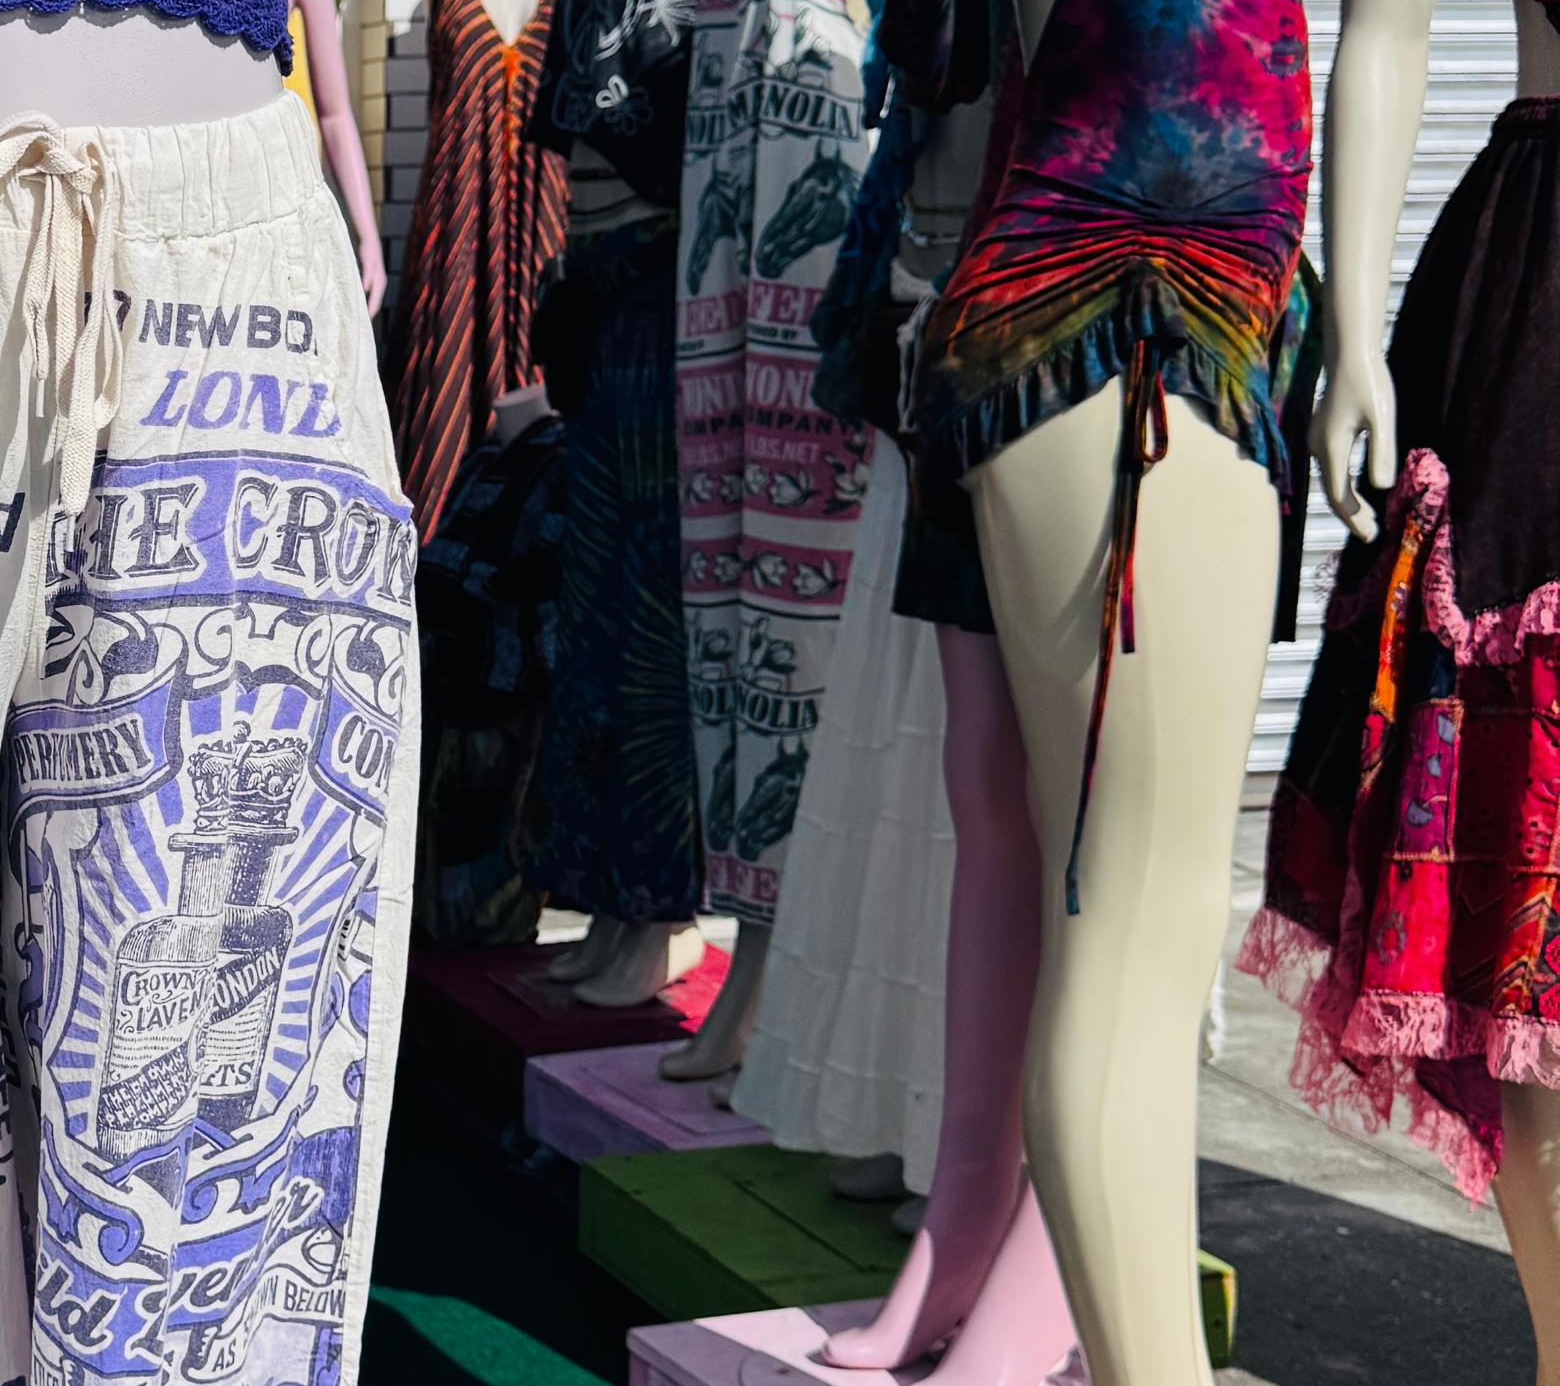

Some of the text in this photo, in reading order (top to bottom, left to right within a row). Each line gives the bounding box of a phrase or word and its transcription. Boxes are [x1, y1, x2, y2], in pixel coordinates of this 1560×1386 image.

[139, 299, 241, 349] NEW
[246, 304, 318, 356] BO
[211, 1337, 236, 1372] AS
[283, 1279, 346, 1318] BELOW
